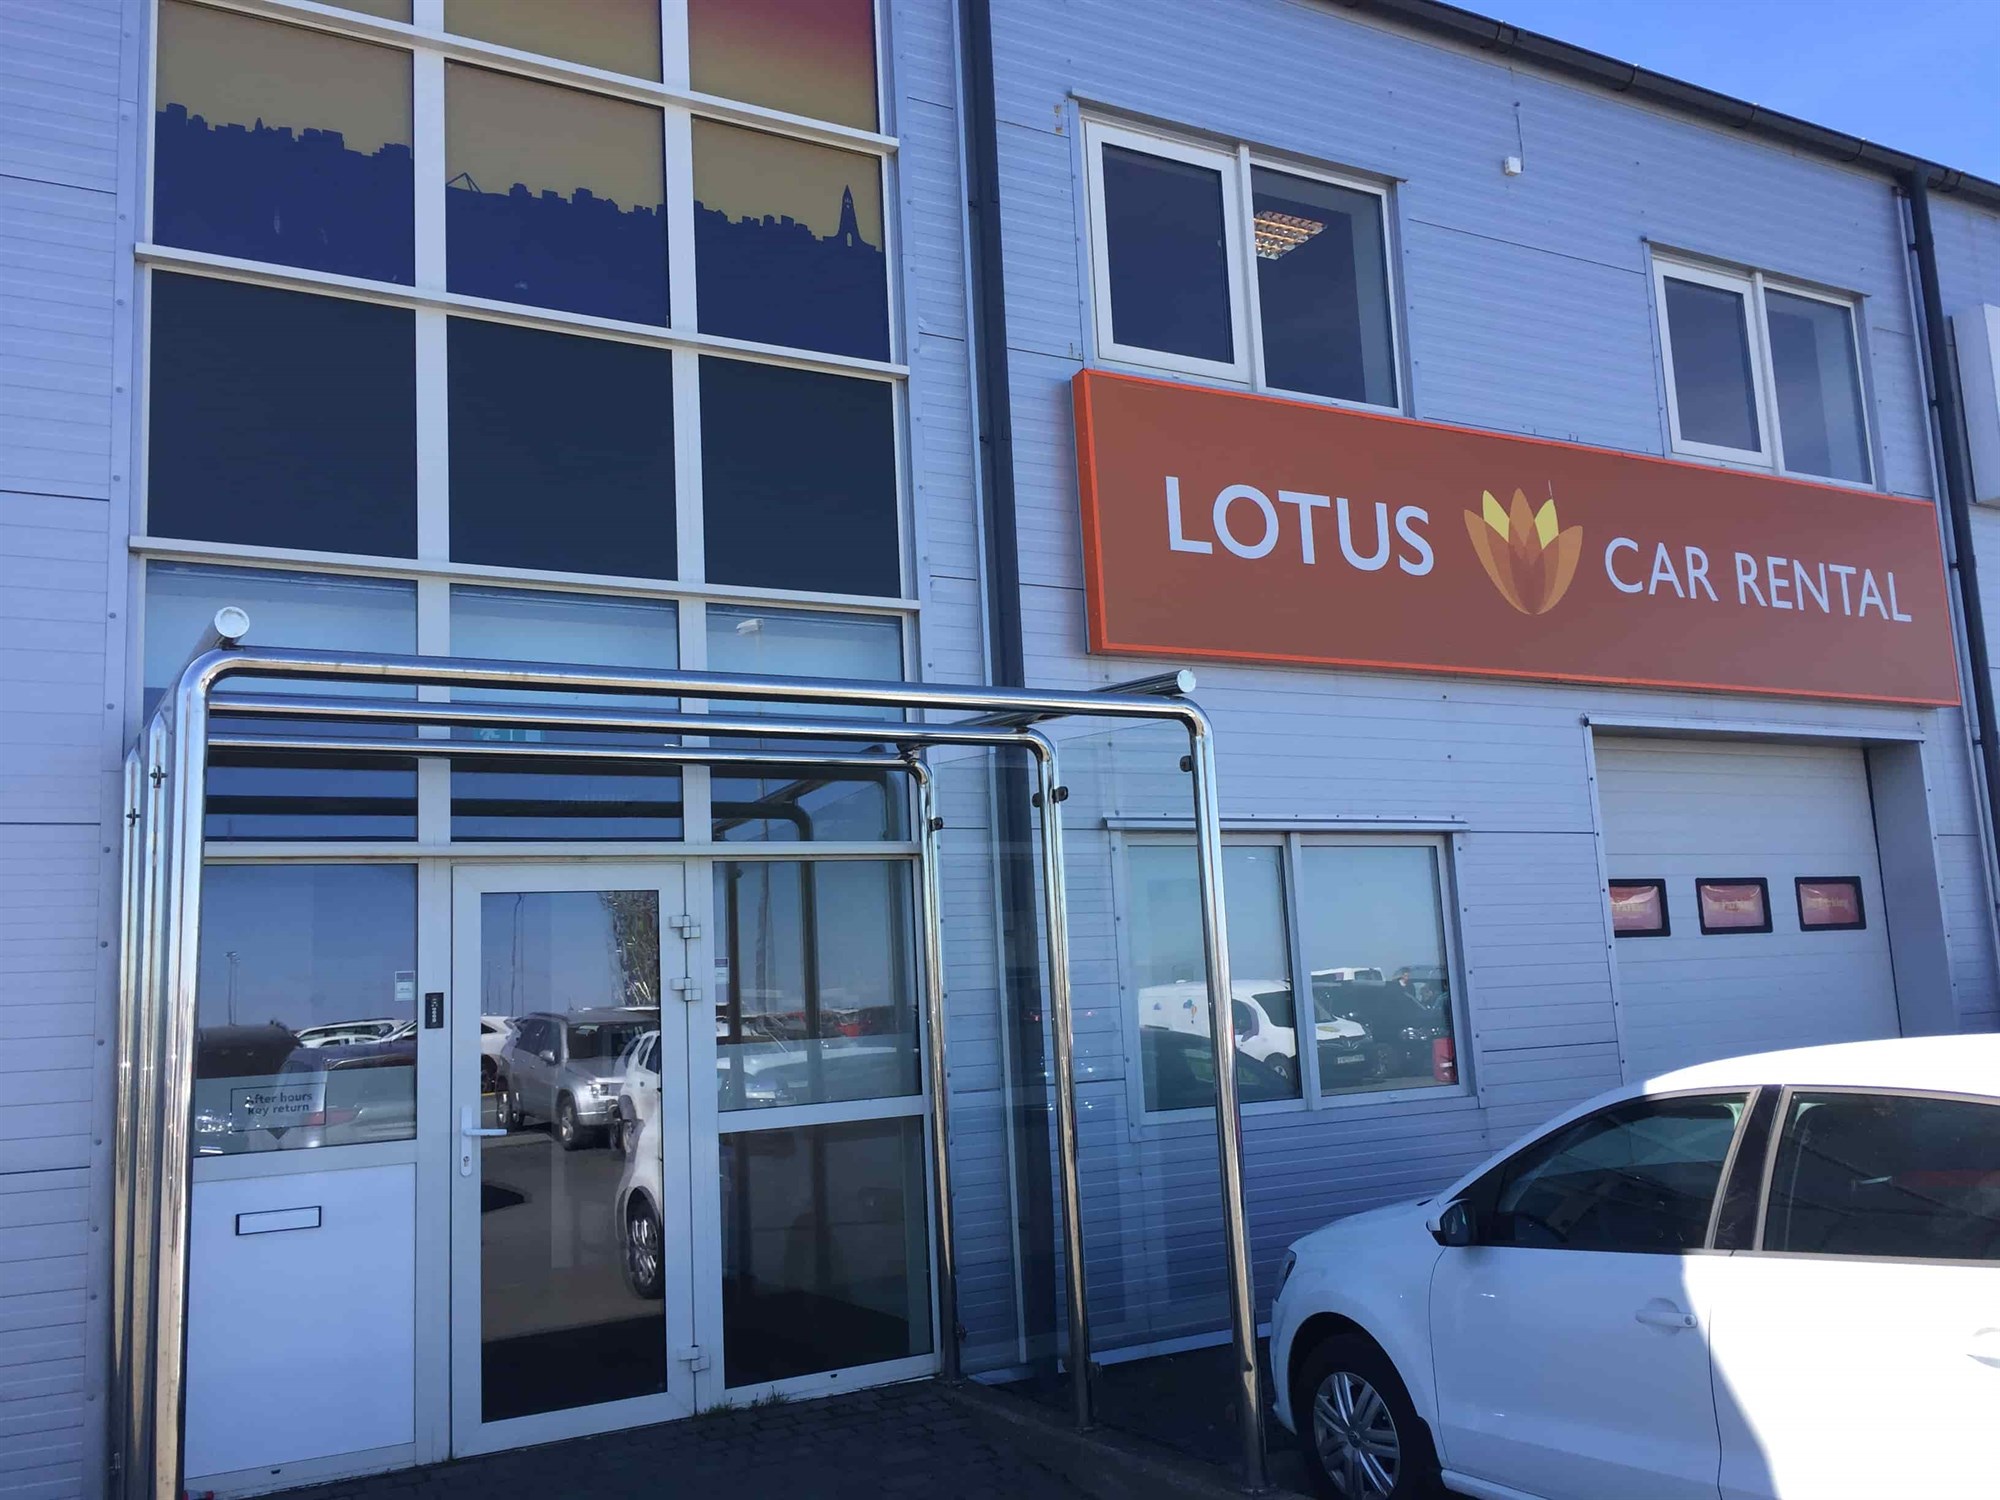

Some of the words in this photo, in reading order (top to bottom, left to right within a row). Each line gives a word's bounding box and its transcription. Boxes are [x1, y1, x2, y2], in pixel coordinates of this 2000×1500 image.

[1165, 475, 1435, 577] LOTUS
[1603, 537, 1719, 602] CAR
[1734, 551, 1914, 623] RENTAL
[280, 1092, 313, 1103] hours
[272, 1103, 310, 1114] return
